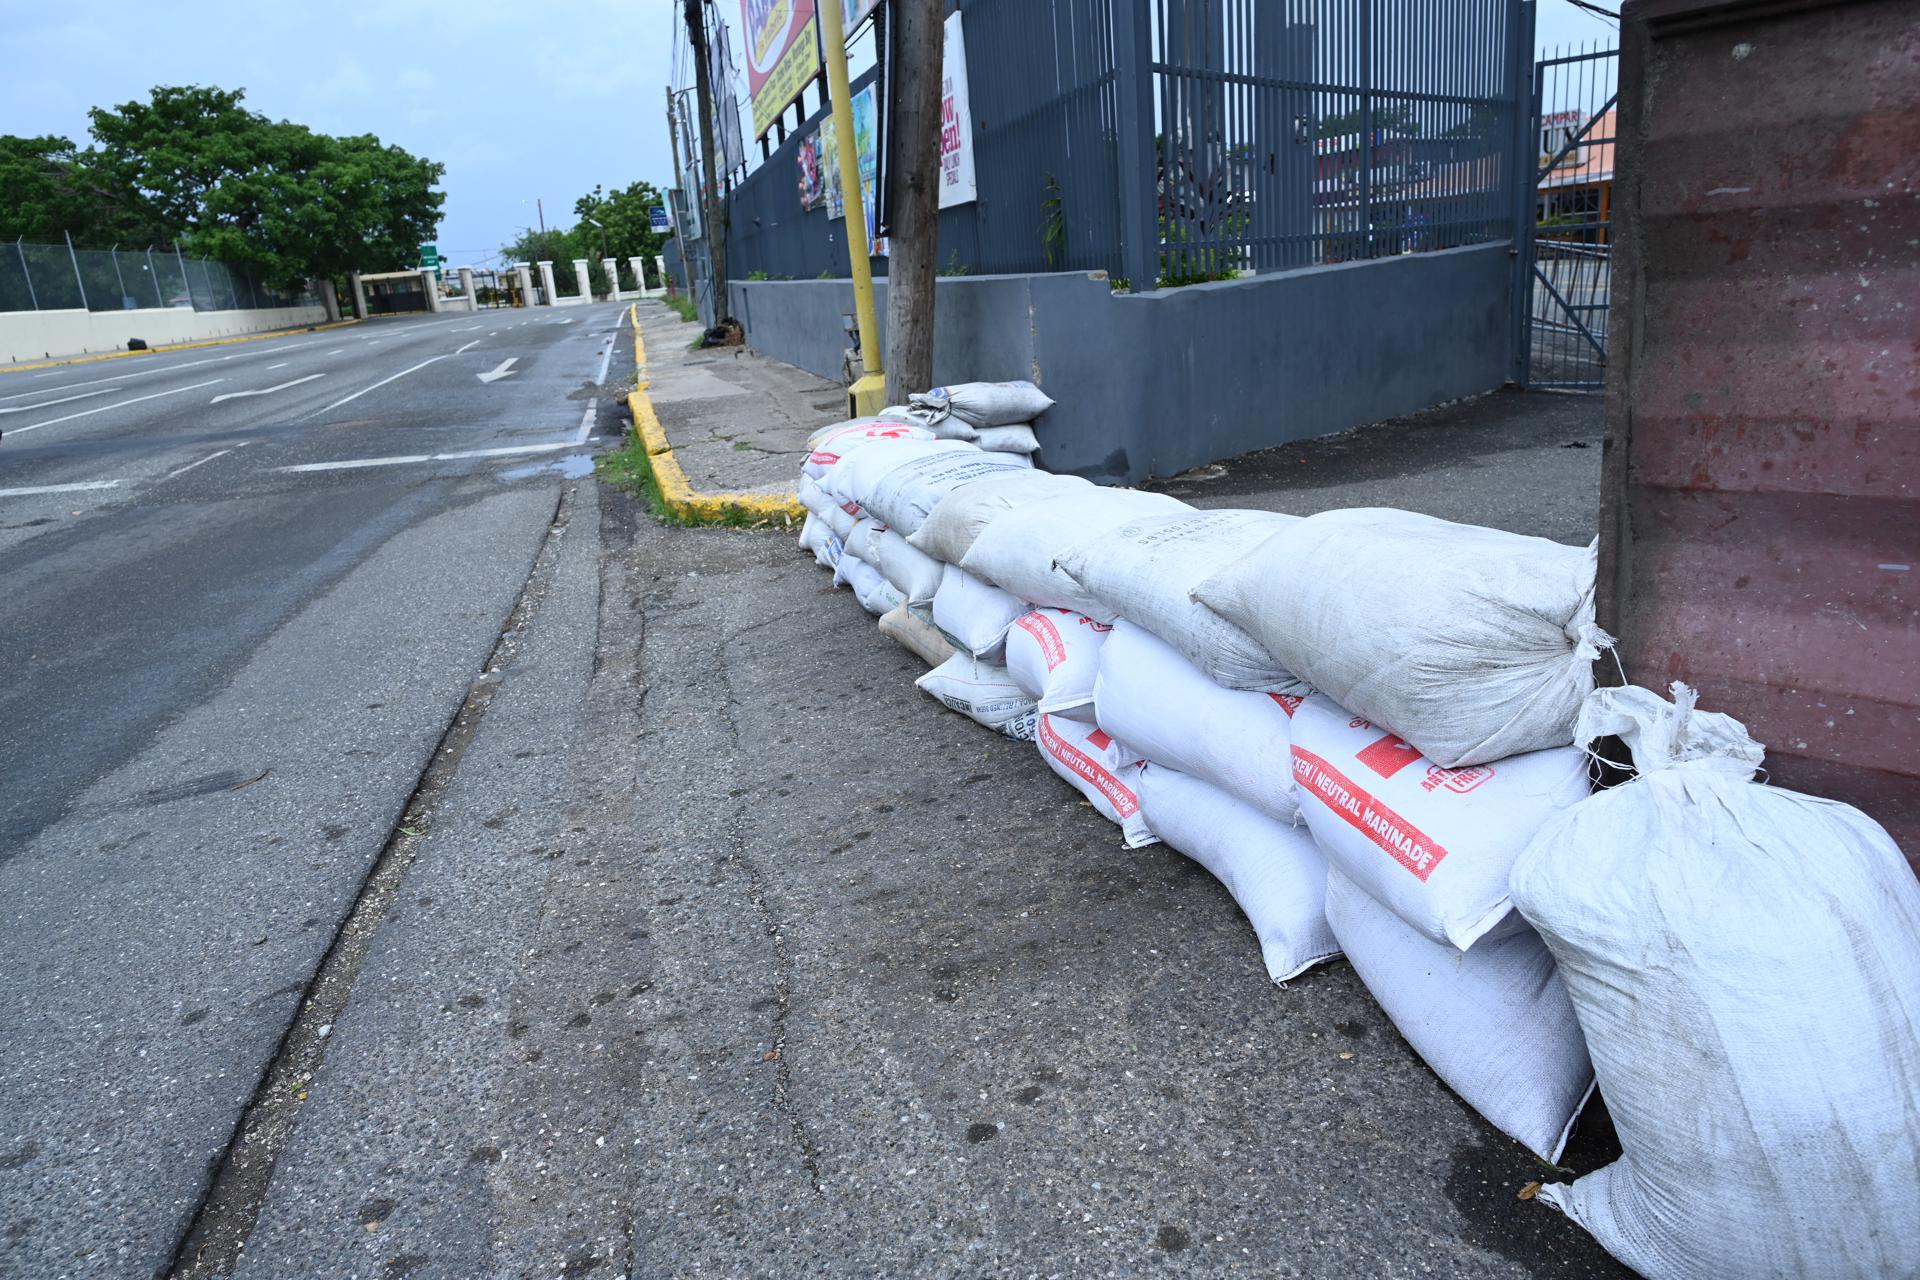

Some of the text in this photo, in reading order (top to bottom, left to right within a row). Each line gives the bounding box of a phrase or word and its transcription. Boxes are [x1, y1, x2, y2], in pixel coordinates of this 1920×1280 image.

[1541, 111, 1580, 127] CAMPAR
[1061, 749, 1095, 780] NEUTRAL
[1096, 773, 1135, 812] MARINADE
[1314, 771, 1362, 818] NEUTRAL
[1362, 806, 1434, 871] MARINADE
